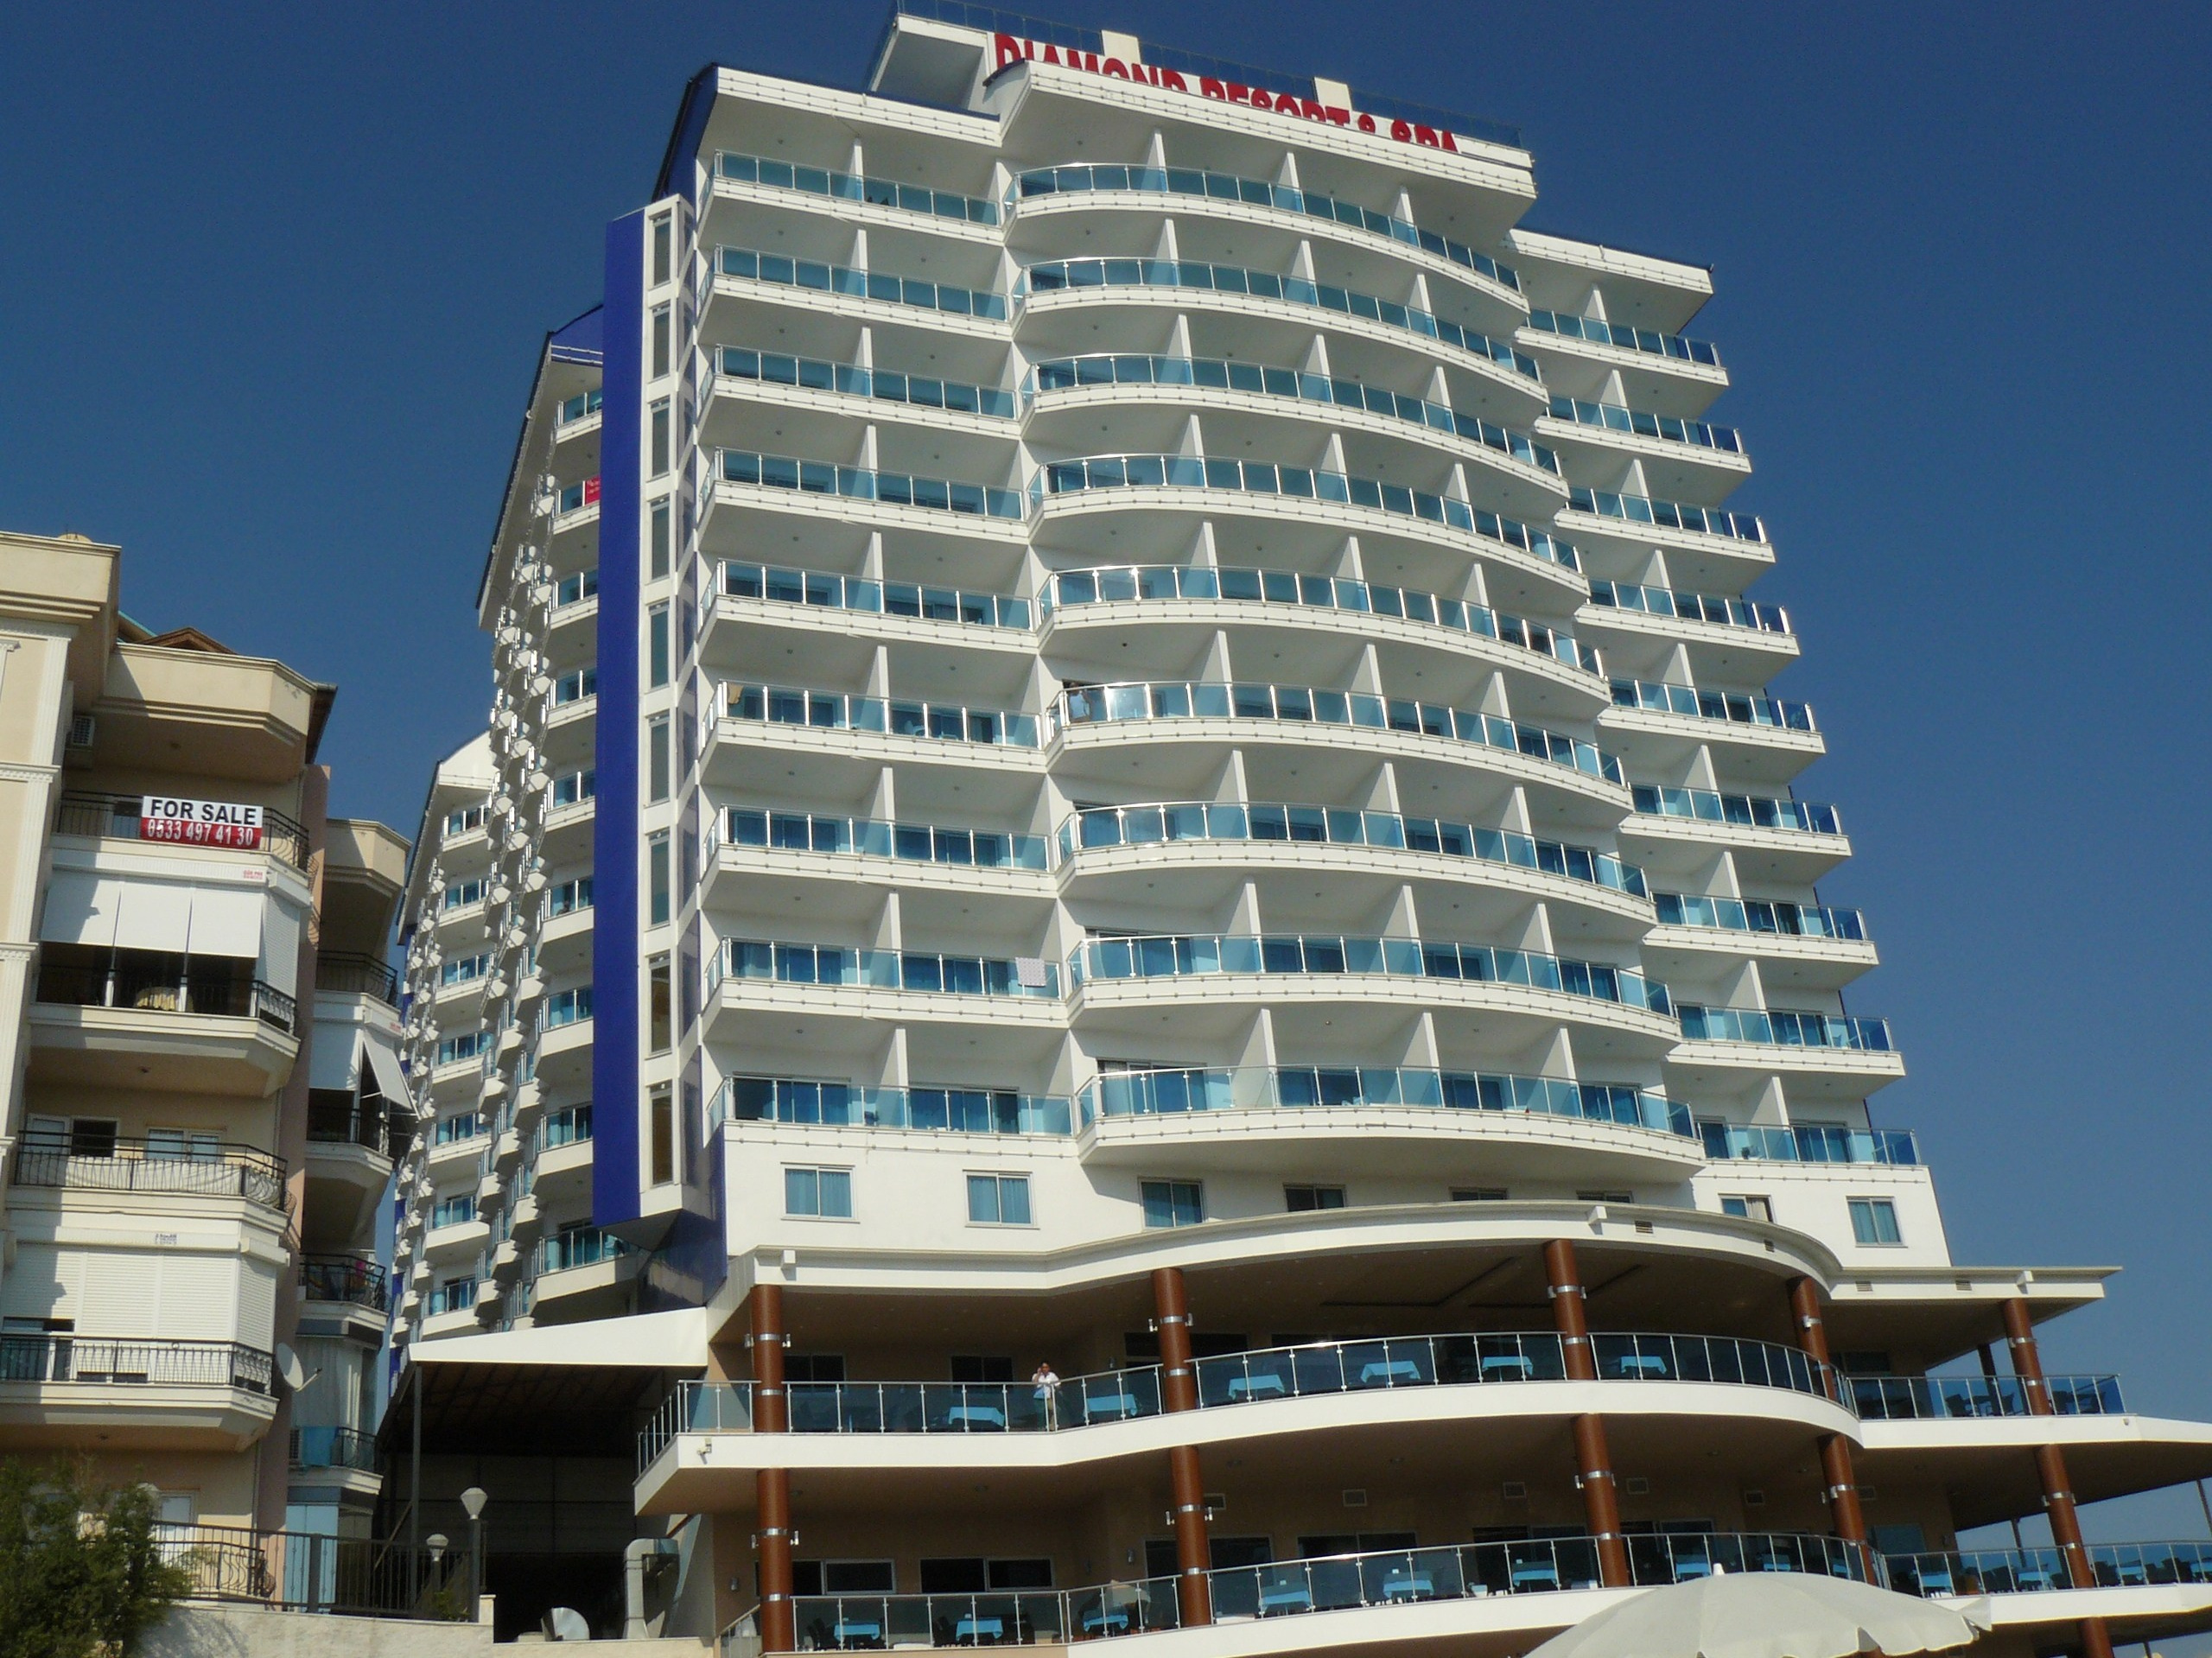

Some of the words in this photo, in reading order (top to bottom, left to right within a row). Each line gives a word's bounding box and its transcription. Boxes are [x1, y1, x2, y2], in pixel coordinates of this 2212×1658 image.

[150, 799, 194, 820] FOR
[201, 804, 257, 825] SALE
[148, 819, 181, 840] 0533
[186, 822, 213, 842] 497
[216, 825, 232, 844] 41
[237, 827, 254, 846] 30
